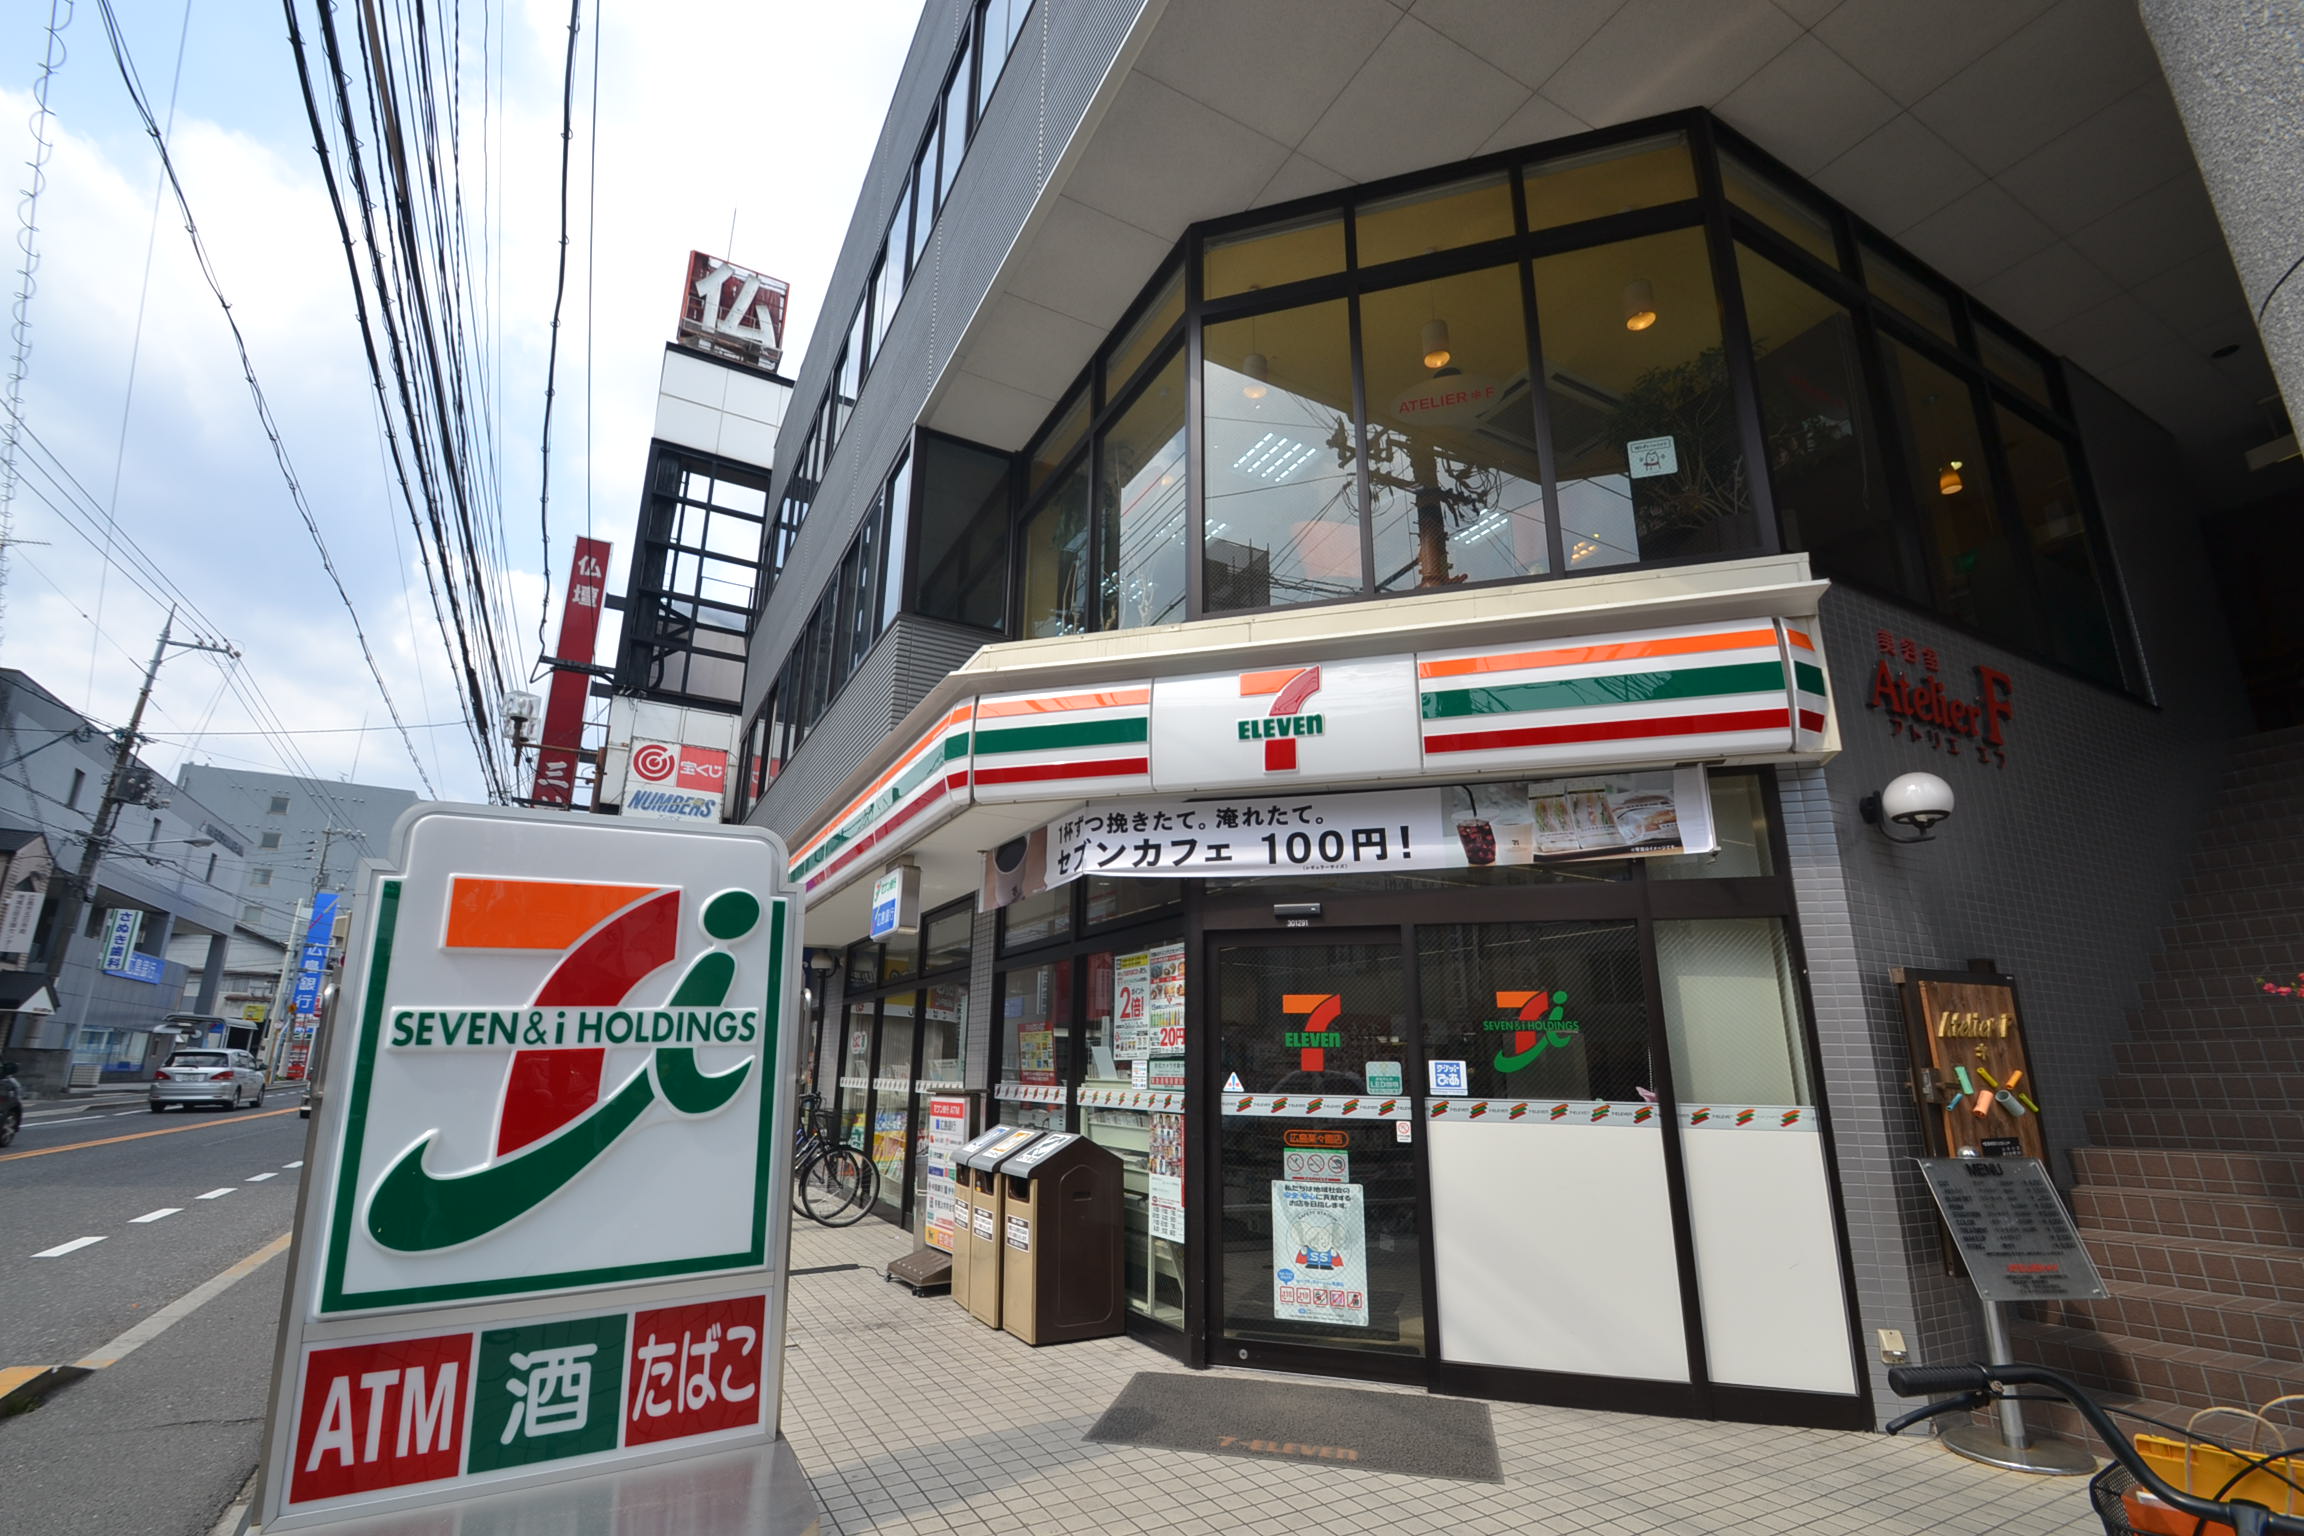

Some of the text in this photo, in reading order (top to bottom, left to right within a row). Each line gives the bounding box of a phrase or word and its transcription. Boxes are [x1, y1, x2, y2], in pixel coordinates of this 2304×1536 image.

[695, 262, 777, 348] 仏
[1399, 391, 1467, 413] ATELIER
[572, 555, 602, 608] 仏壇
[1872, 659, 2014, 746] Atelier F
[680, 761, 722, 778] 宝くじ
[627, 790, 716, 818] NUMBERS
[1057, 837, 1233, 876] セブンカフェ
[106, 911, 134, 969] さぬき歯科
[578, 1009, 757, 1046] HOLDINGS
[1527, 1021, 1580, 1031] HOLDINGS
[1437, 1074, 1460, 1086] ぴあ
[1964, 1162, 2004, 1178] MENU
[1310, 1251, 1329, 1263] SS
[632, 1322, 757, 1422] たばこ
[500, 1342, 598, 1445] 酒
[305, 1362, 458, 1472] ATM
